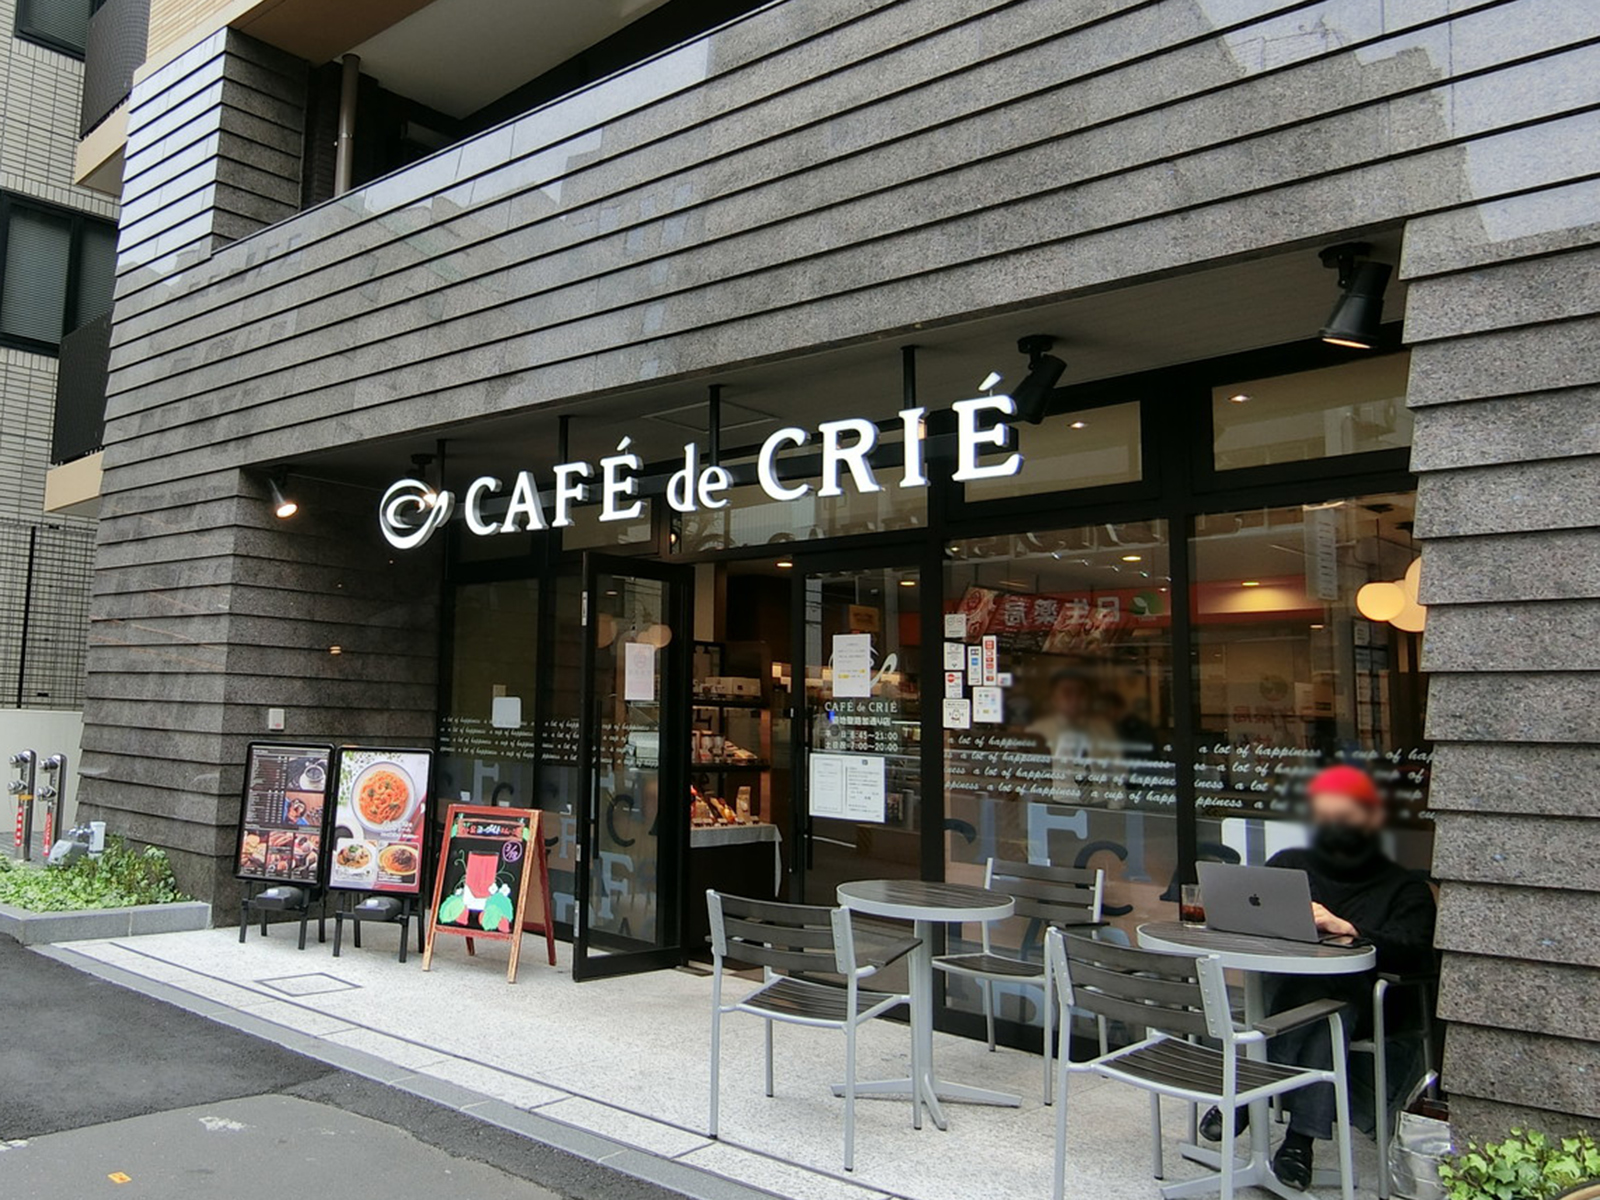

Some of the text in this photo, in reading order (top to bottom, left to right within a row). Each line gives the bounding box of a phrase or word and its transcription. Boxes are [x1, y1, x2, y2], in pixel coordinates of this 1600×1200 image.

[464, 371, 1025, 536] CAFÉ de CRIÉ
[824, 700, 898, 712] CAFÉ de CRIÉ
[958, 735, 972, 744] lot
[974, 736, 985, 748] of
[988, 736, 1036, 748] happiness
[971, 751, 984, 760] lot
[988, 752, 998, 764] of
[1002, 751, 1051, 764] happiness
[1198, 746, 1208, 754] a
[1214, 744, 1231, 754] lot
[1236, 744, 1250, 758] of
[1255, 744, 1322, 758] happiness
[1386, 748, 1402, 764] of
[984, 766, 998, 776] lot
[1001, 768, 1012, 780] of
[1016, 768, 1066, 780] happiness
[1088, 774, 1107, 784] cup
[1112, 774, 1126, 786] of
[1216, 764, 1226, 772] a
[1232, 762, 1250, 772] lot
[1255, 762, 1269, 777] of
[1408, 768, 1424, 784] of
[998, 782, 1012, 792] lot
[1015, 784, 1028, 796] of
[1030, 784, 1081, 797] happiness
[1104, 790, 1124, 801] cup
[1129, 790, 1142, 804] of
[1146, 790, 1176, 804] happ
[1234, 782, 1244, 790] a
[1250, 780, 1269, 792] lot
[1194, 796, 1243, 808] ppiness
[1254, 800, 1264, 809] a
